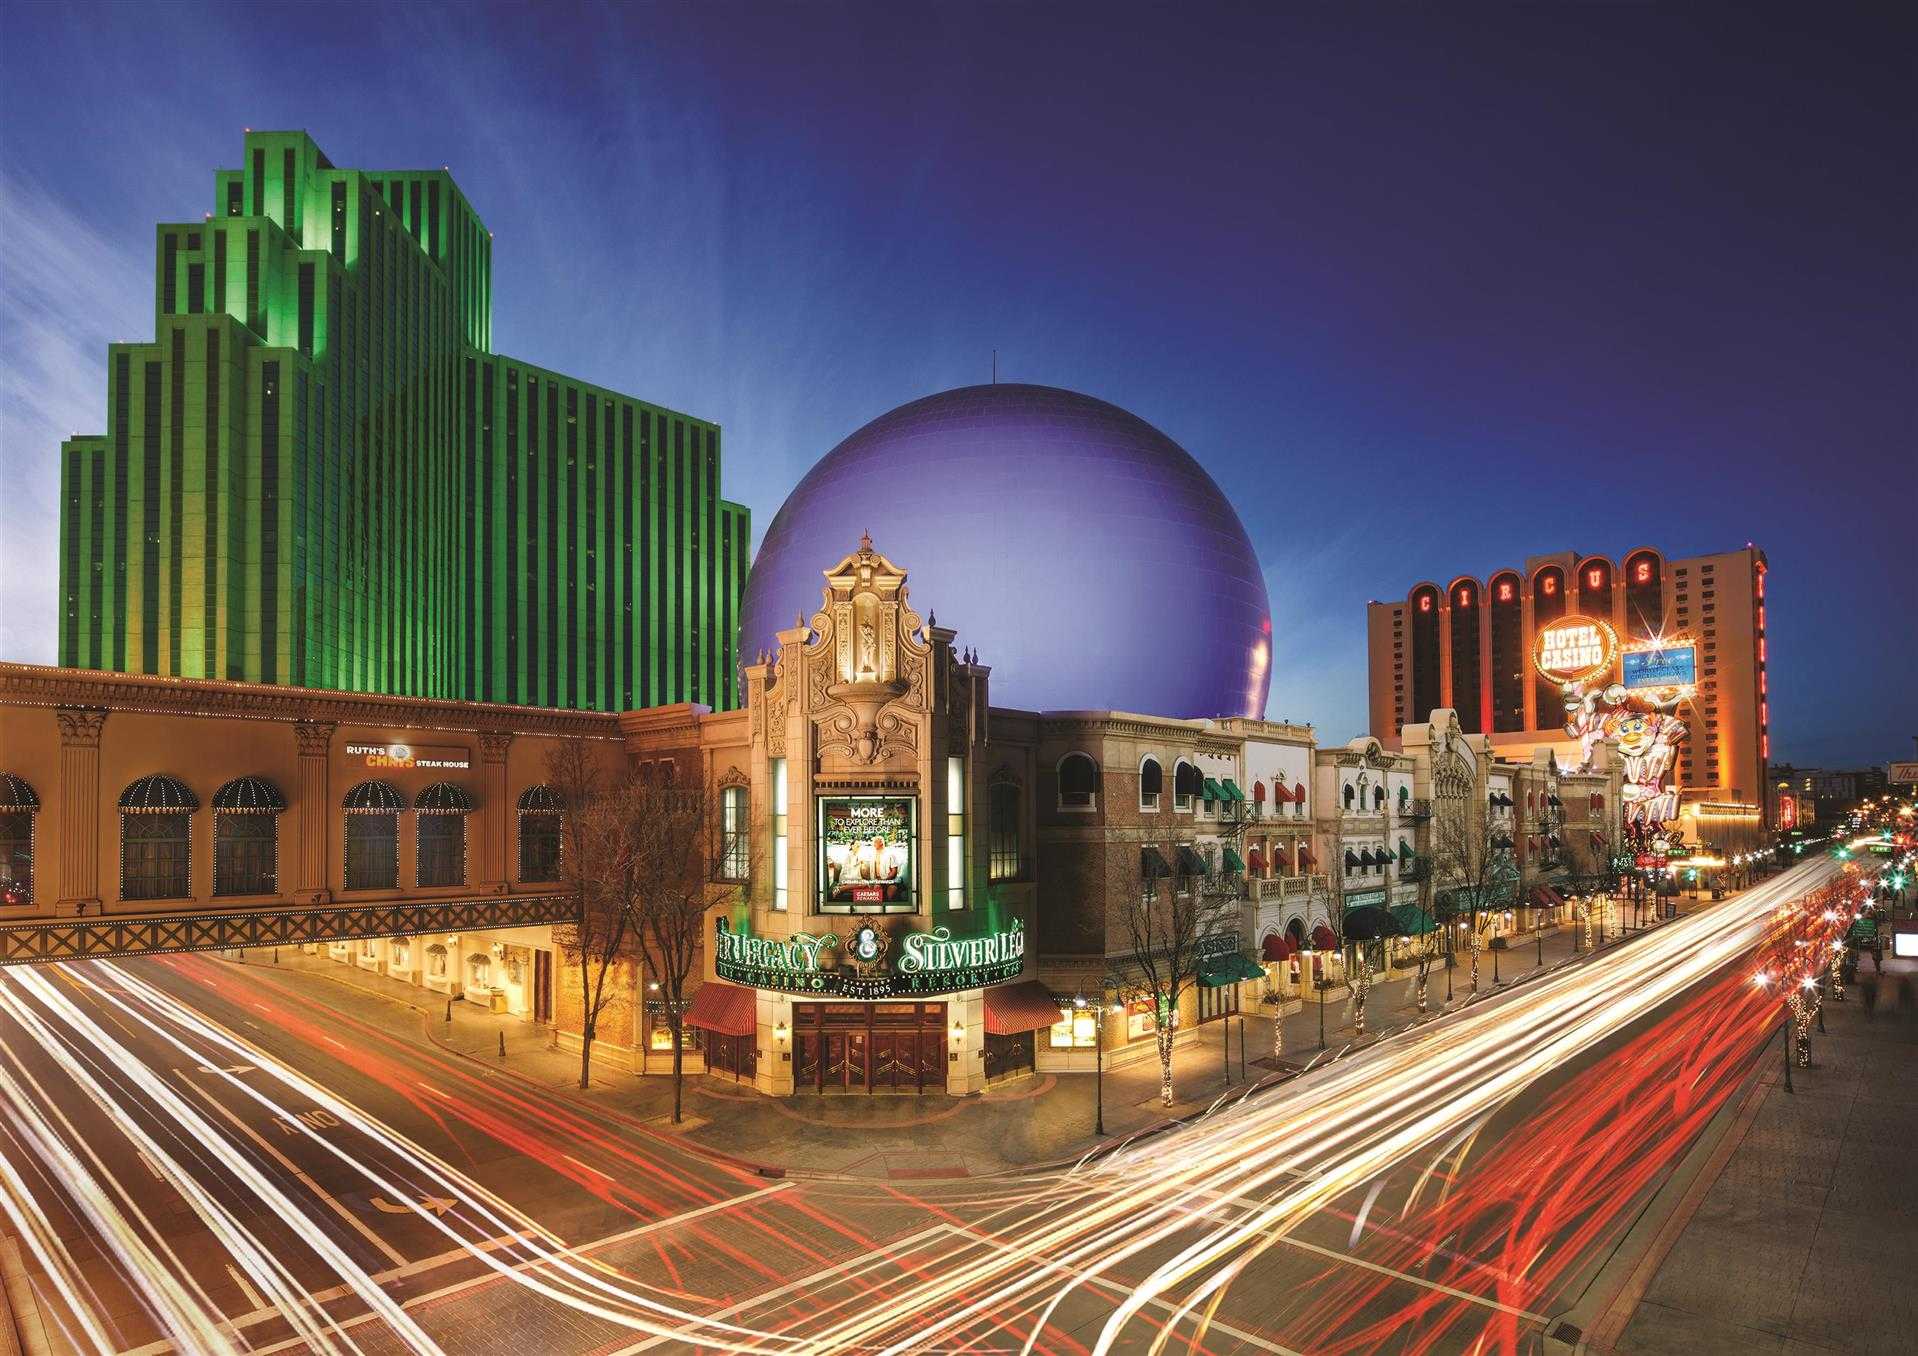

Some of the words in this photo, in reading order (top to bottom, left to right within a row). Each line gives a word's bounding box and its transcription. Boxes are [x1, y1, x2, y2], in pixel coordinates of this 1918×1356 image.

[1420, 563, 1649, 611] CIRCUS
[1543, 624, 1600, 650] HOTEL
[1541, 646, 1602, 670] CASINO
[346, 746, 386, 755] RUTH'S
[416, 760, 442, 768] STEAK
[443, 761, 469, 769] HOUSE
[850, 807, 884, 818] MORE
[834, 818, 844, 826] TO
[845, 818, 878, 826] EXPLORE
[879, 818, 901, 826] THAN
[843, 825, 862, 833] EVER
[865, 825, 891, 833] BEFORE
[731, 931, 839, 972] LEGACY
[899, 926, 999, 973] SILVER
[746, 970, 824, 989] CASINO
[911, 973, 990, 989] RESORT
[842, 984, 865, 996] EST.
[869, 984, 891, 996] 1895
[272, 1110, 341, 1136] ONY
